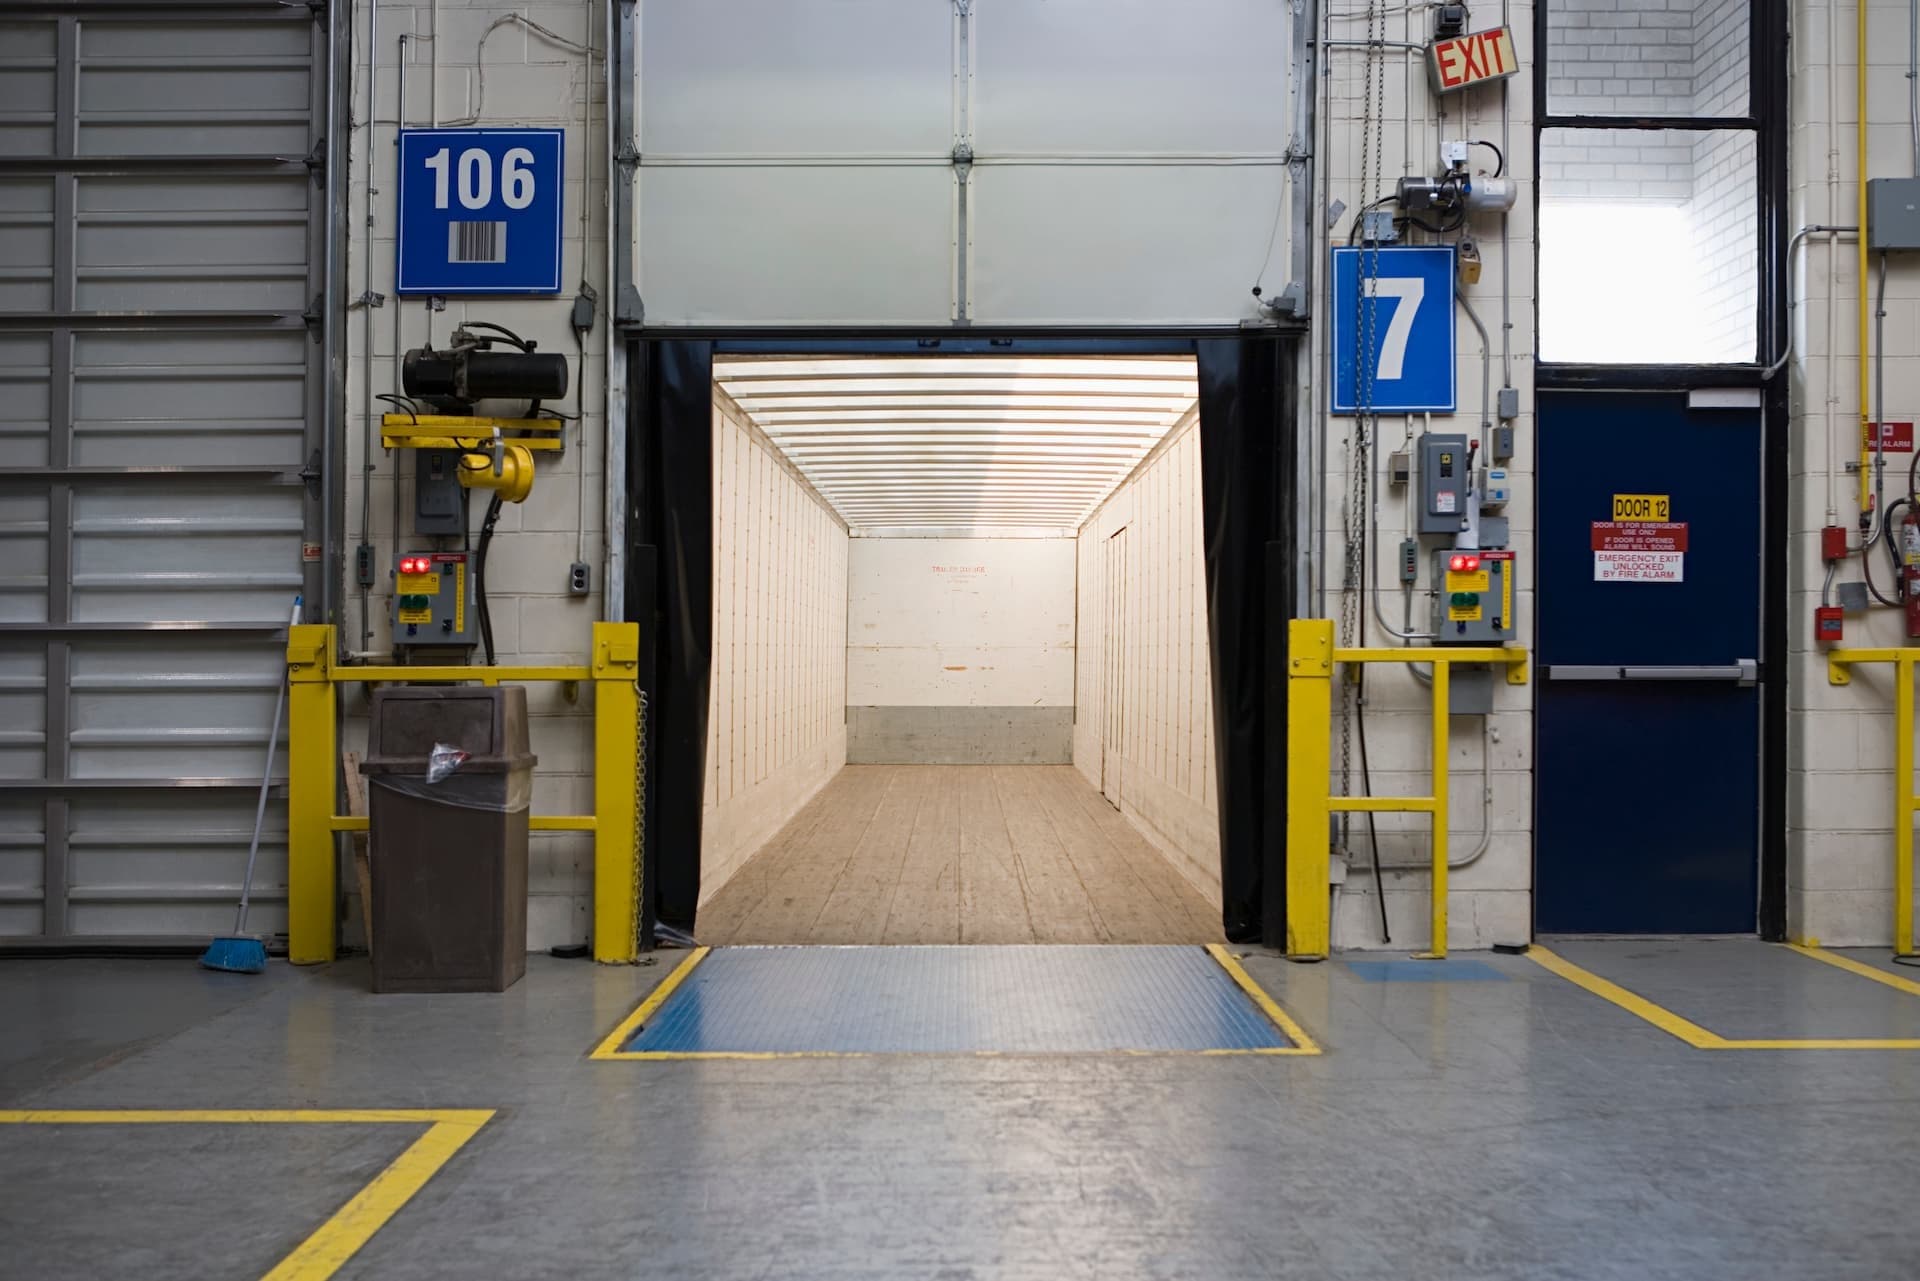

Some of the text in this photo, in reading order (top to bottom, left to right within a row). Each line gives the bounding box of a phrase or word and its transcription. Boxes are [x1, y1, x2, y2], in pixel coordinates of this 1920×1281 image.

[1436, 29, 1504, 87] EXIT
[425, 147, 535, 210] 106
[1365, 278, 1425, 380] 7
[1882, 440, 1911, 448] ALARM
[1615, 499, 1667, 517] DOOR 12
[1599, 554, 1680, 563] EMERGENCY EXIT
[1613, 563, 1664, 571] UNLOCKED
[1603, 570, 1675, 579] BY FIRE ALARM
